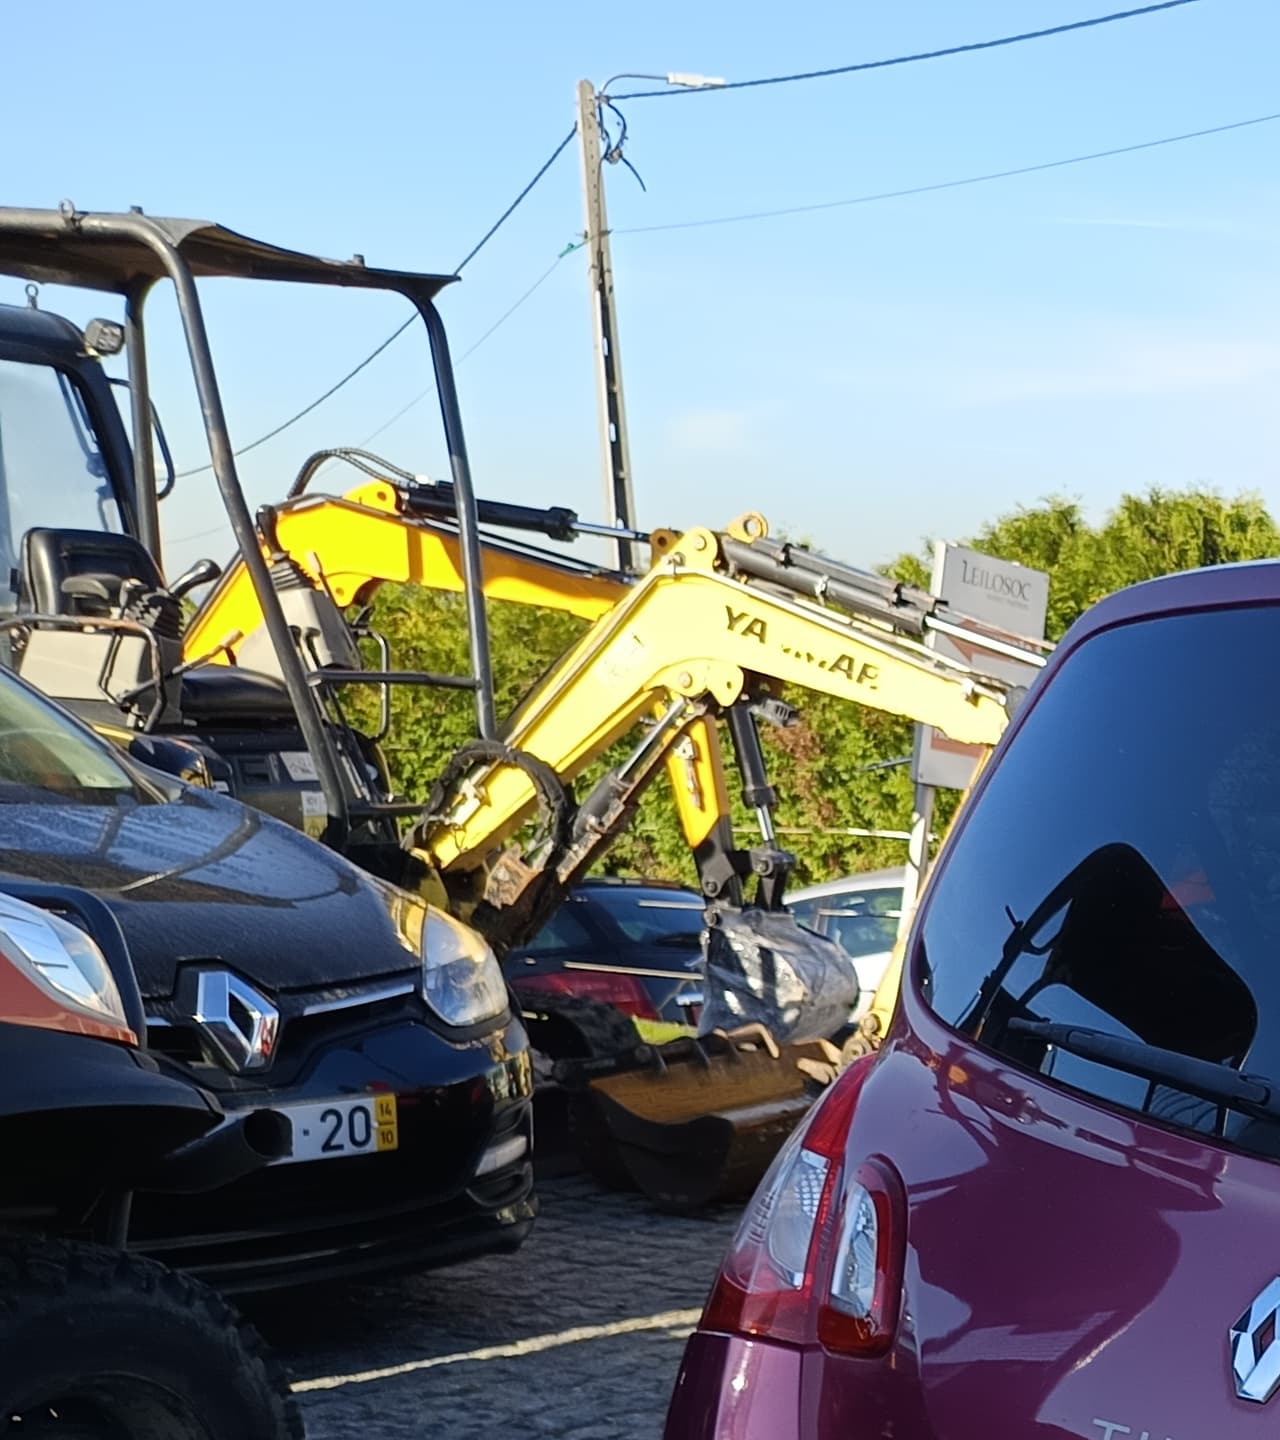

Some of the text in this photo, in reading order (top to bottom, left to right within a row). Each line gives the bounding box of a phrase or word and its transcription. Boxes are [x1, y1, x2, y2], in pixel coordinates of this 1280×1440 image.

[961, 559, 1031, 601] LEILOSOC
[725, 604, 880, 690] YAAR
[379, 1102, 393, 1118] 14
[380, 1129, 395, 1146] 10
